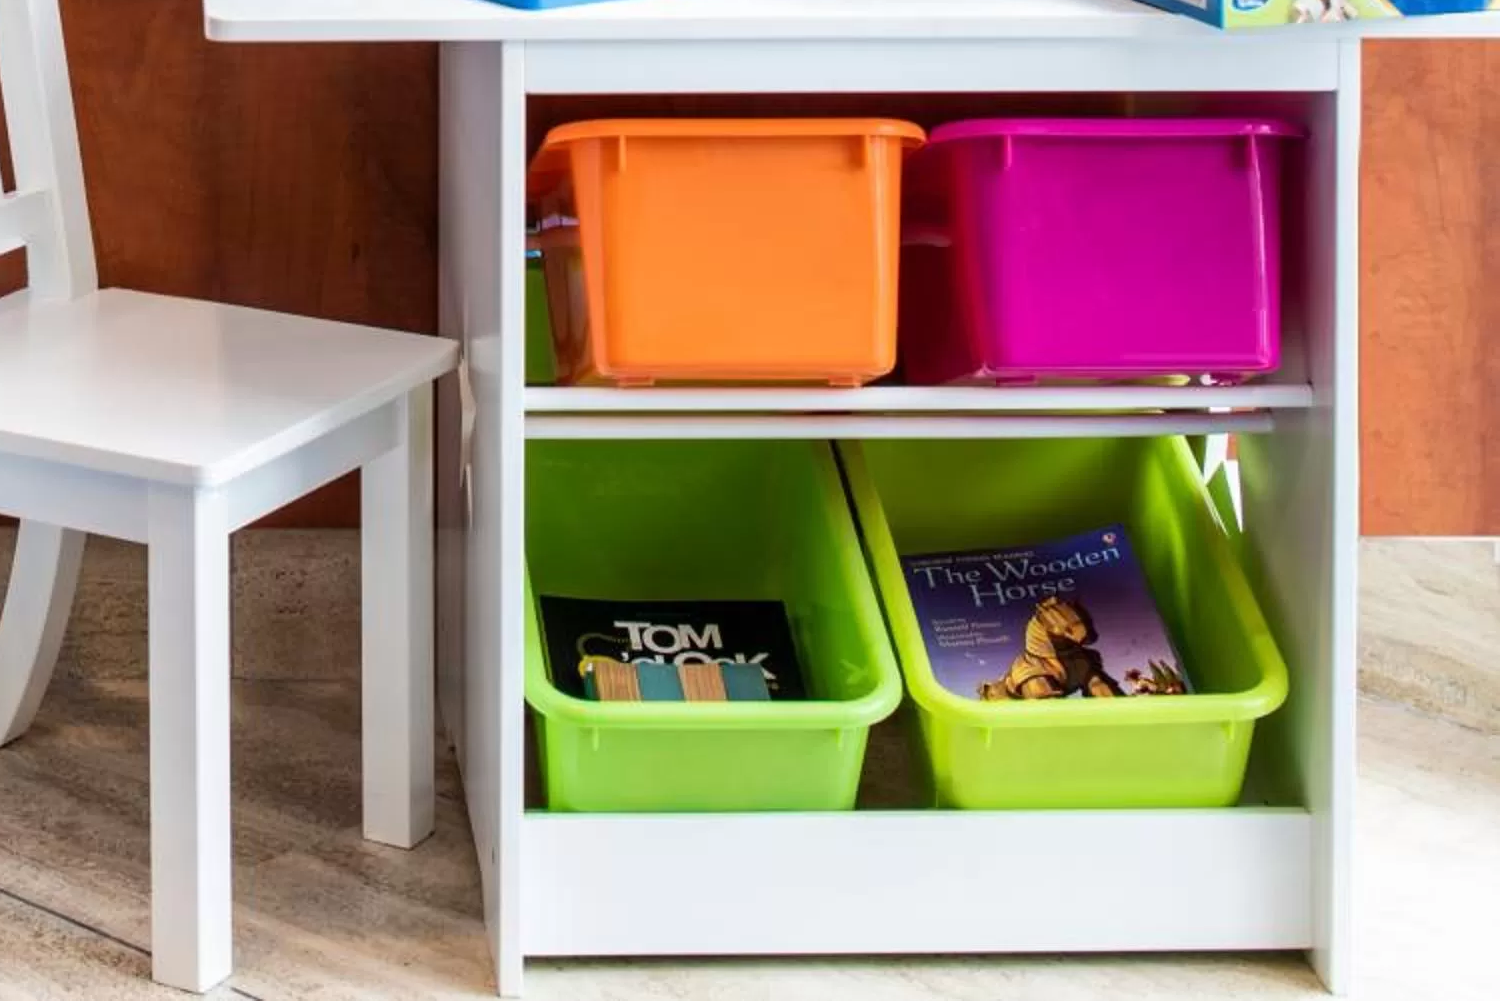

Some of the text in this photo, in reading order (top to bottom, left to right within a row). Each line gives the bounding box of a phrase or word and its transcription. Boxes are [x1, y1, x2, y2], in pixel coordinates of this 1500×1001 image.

[914, 566, 982, 589] The
[985, 546, 1121, 582] Wooden
[968, 576, 1076, 608] Horse
[614, 620, 724, 654] TOM
